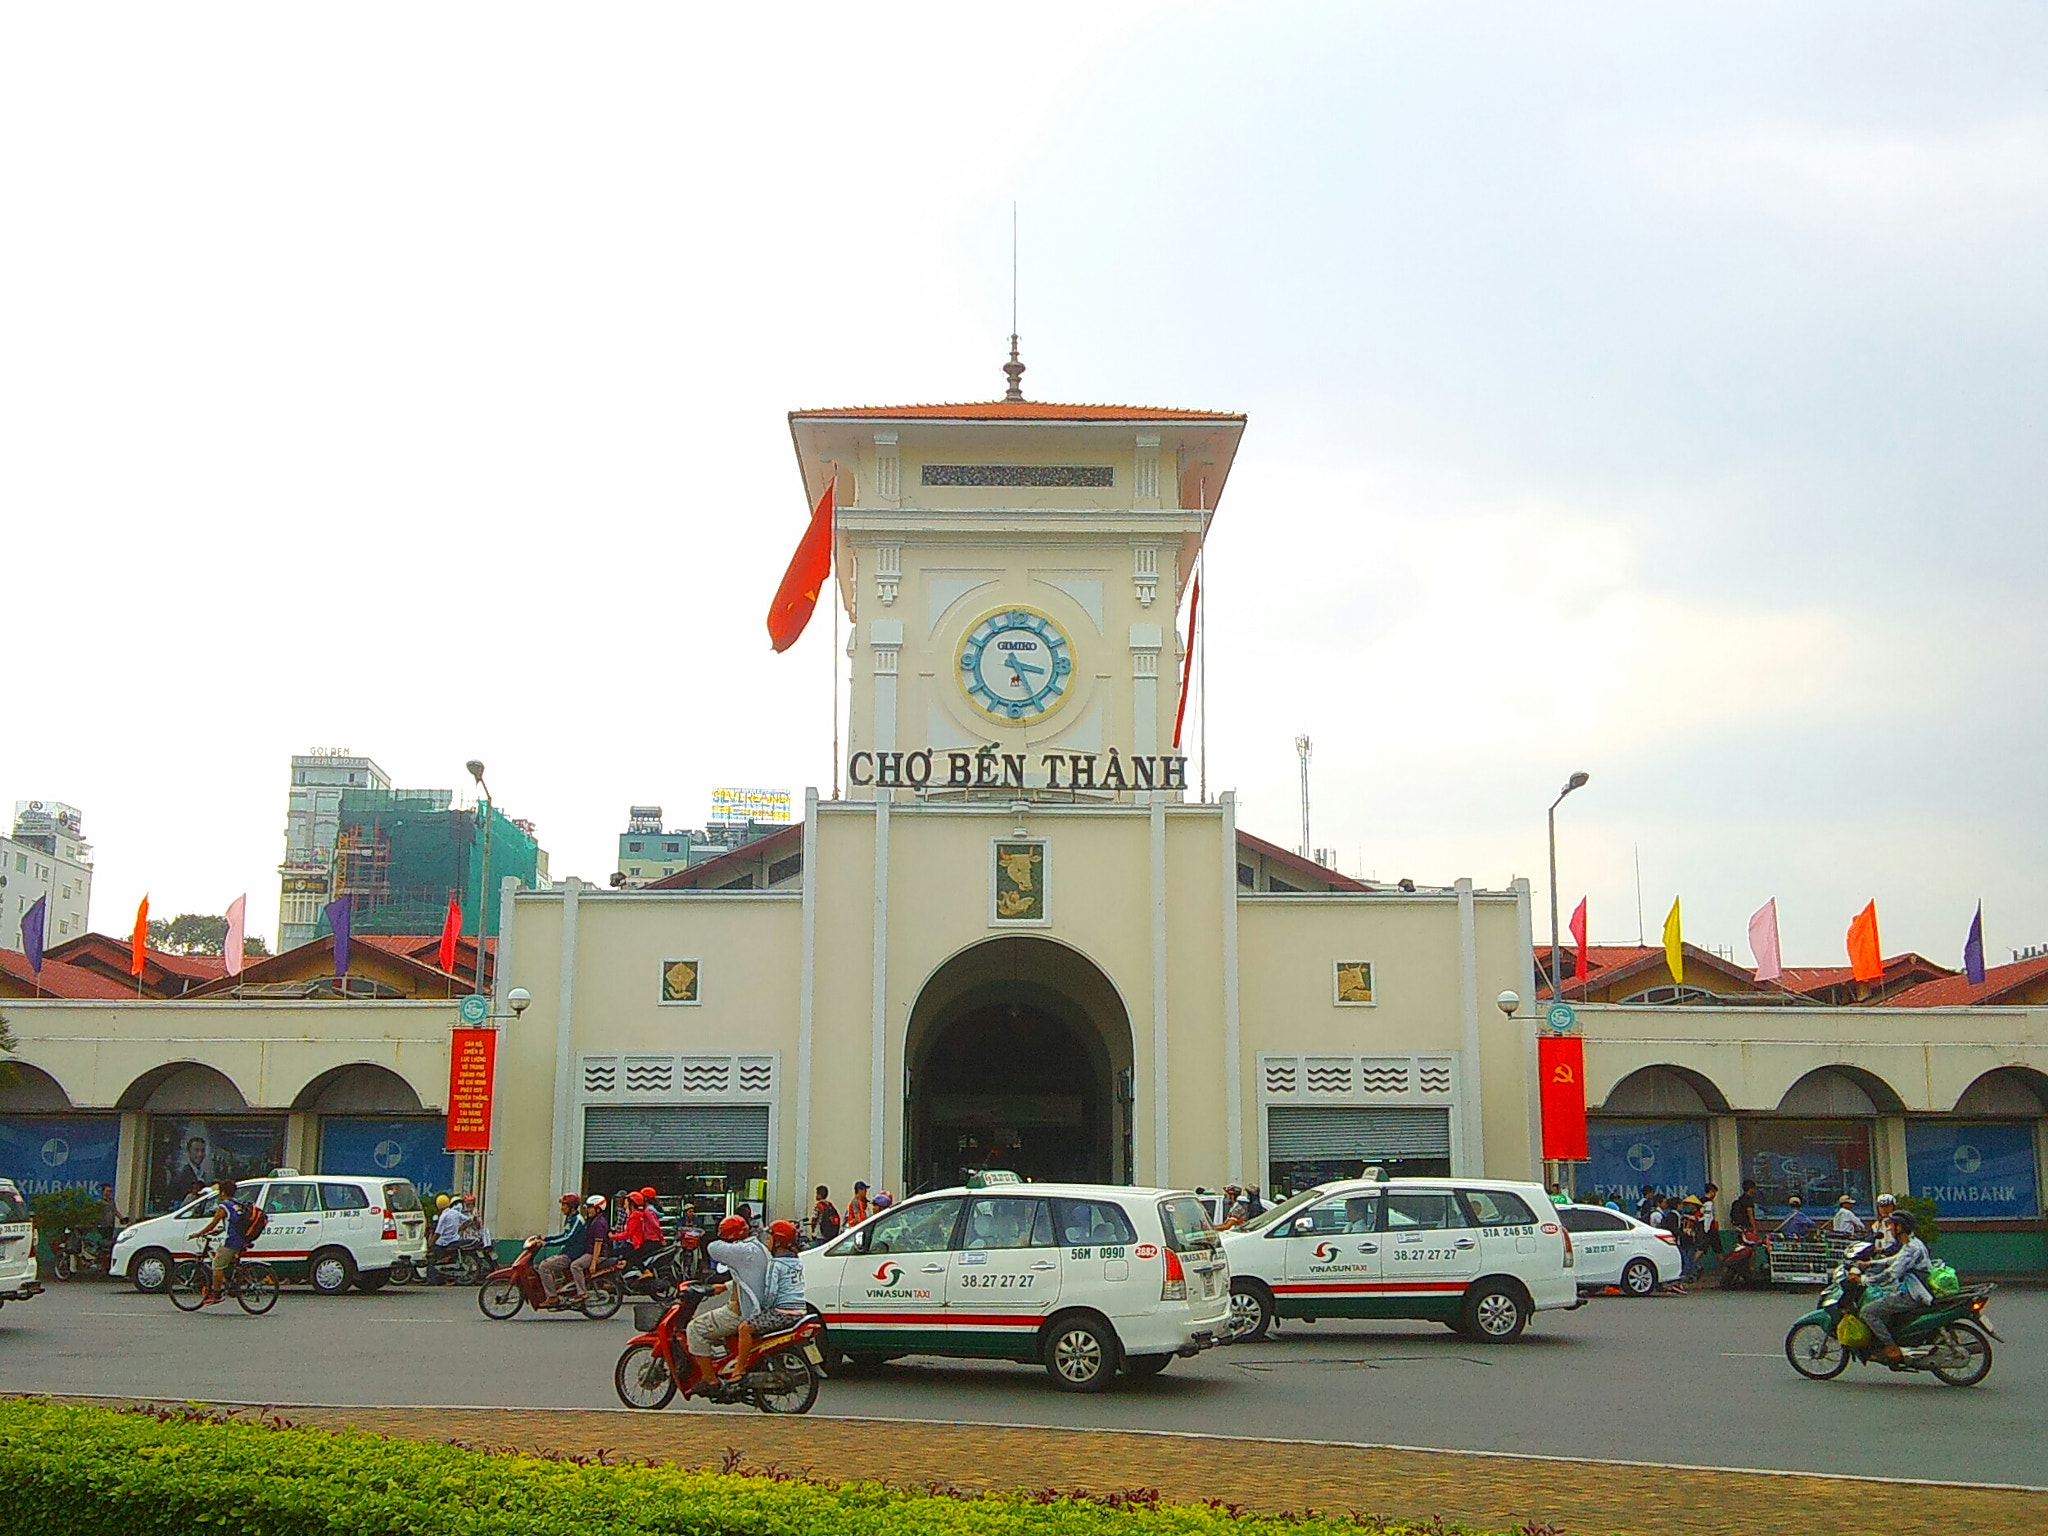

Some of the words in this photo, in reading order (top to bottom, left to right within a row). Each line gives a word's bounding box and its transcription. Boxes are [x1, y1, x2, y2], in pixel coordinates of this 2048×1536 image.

[849, 748, 933, 791] CHỢ
[948, 742, 1026, 788] BẾN
[1041, 747, 1188, 790] THÀNH
[18, 1180, 102, 1196] XIMBANK
[1594, 1184, 1689, 1200] EXIMANK
[1922, 1186, 2015, 1200] EXIMBANK
[285, 1226, 295, 1235] 27
[296, 1226, 306, 1235] 27
[1483, 1227, 1500, 1237] 51A
[1071, 1248, 1091, 1260] 56M
[1100, 1247, 1125, 1259] 0990
[1394, 1250, 1424, 1261] 38.27
[1428, 1250, 1441, 1260] 27
[1444, 1249, 1457, 1260] 27
[961, 1275, 997, 1288] 38.27
[1000, 1275, 1016, 1288] 27
[1019, 1275, 1034, 1287] 27
[866, 1290, 912, 1298] VINASUN
[913, 1290, 930, 1298] TAXI
